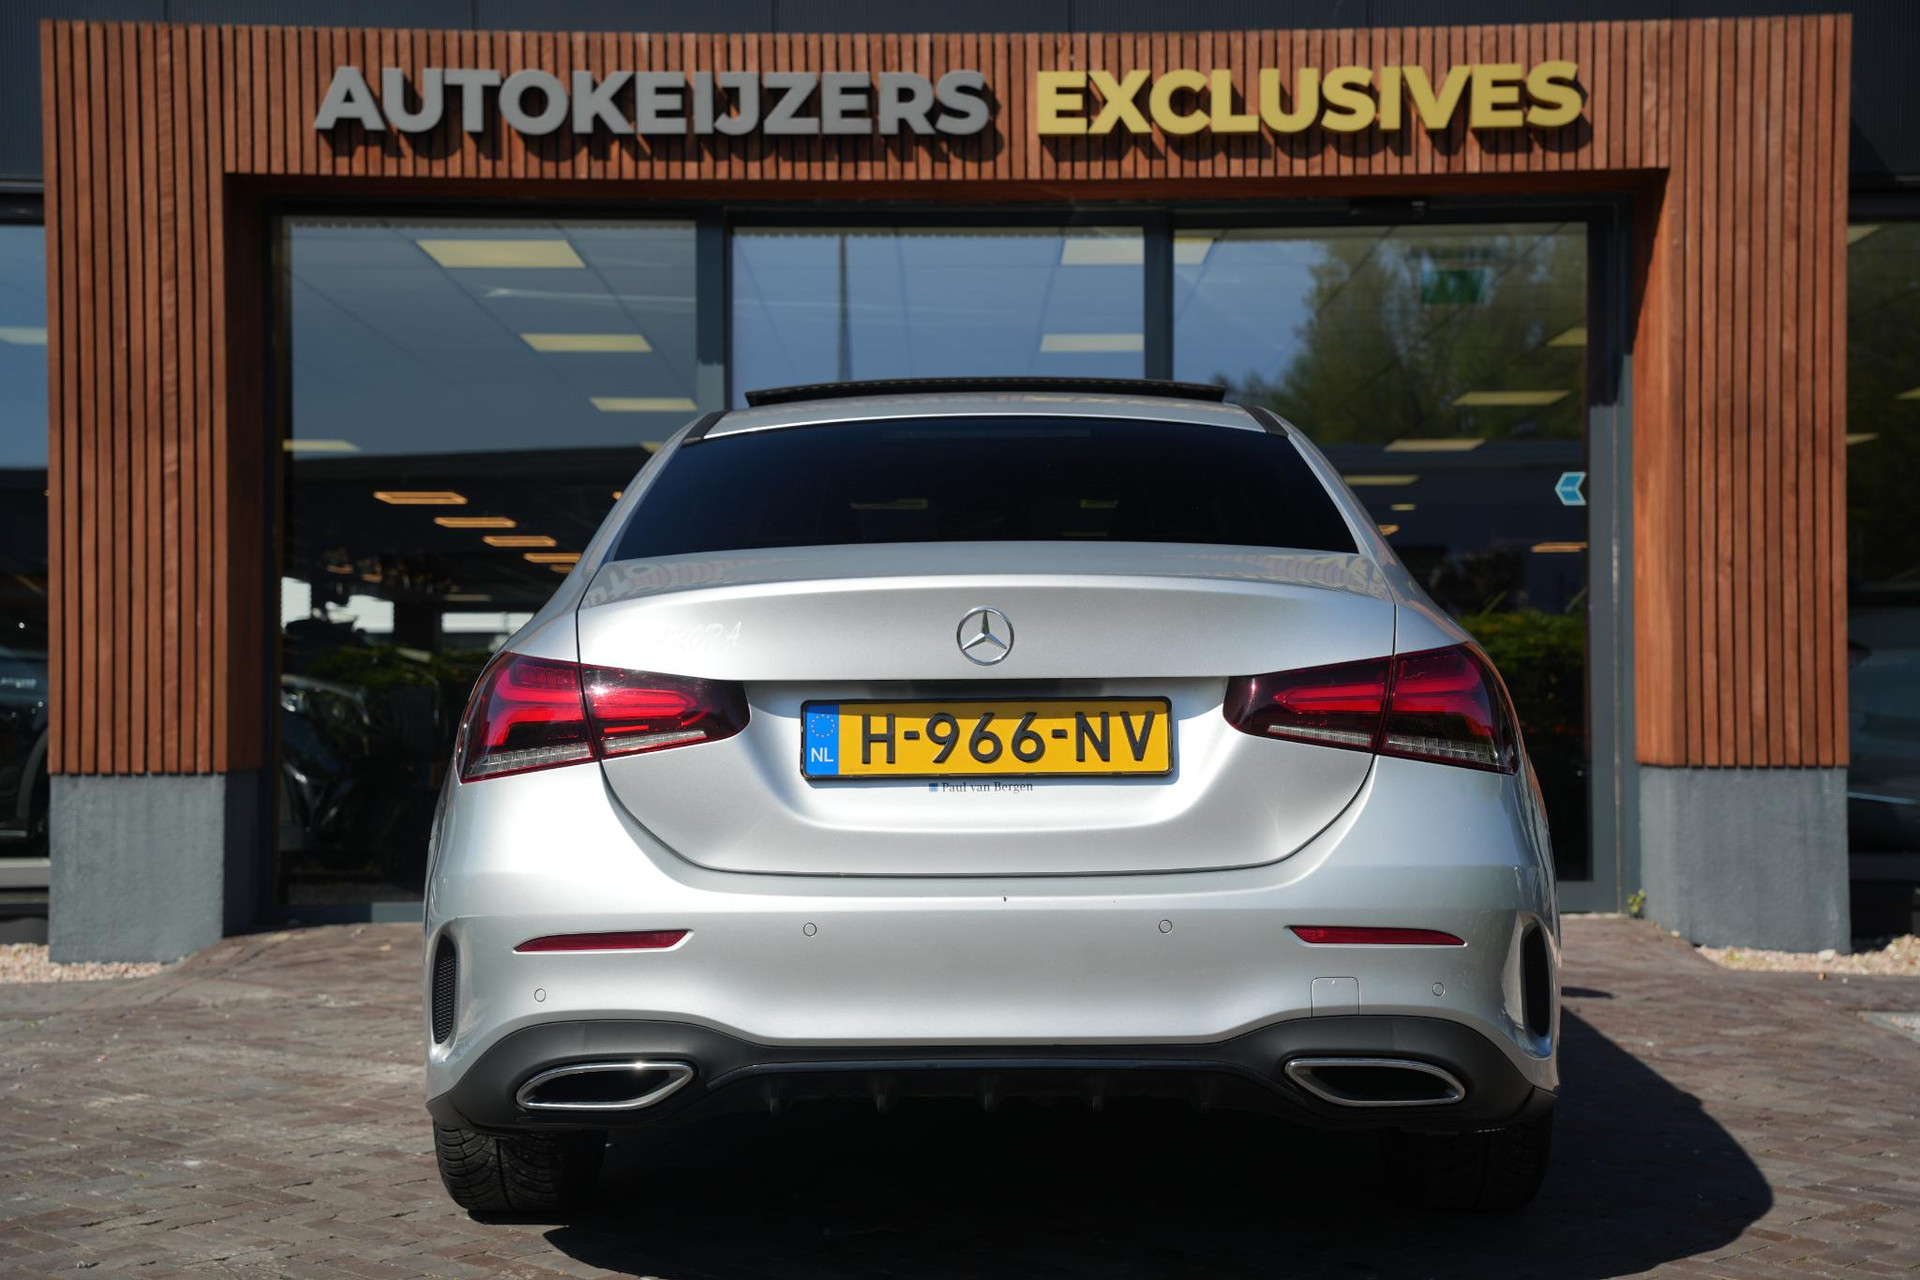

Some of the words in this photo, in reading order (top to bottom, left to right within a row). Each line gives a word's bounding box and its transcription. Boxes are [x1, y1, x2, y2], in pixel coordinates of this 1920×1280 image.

[313, 65, 992, 136] AUTOKEIJZERS
[1036, 59, 1583, 136] EXCLUSIVES
[810, 746, 834, 763] NL
[861, 710, 1156, 765] H-966-NV
[942, 782, 967, 792] Paul
[970, 784, 990, 792] van
[994, 781, 1034, 793] Bergen
